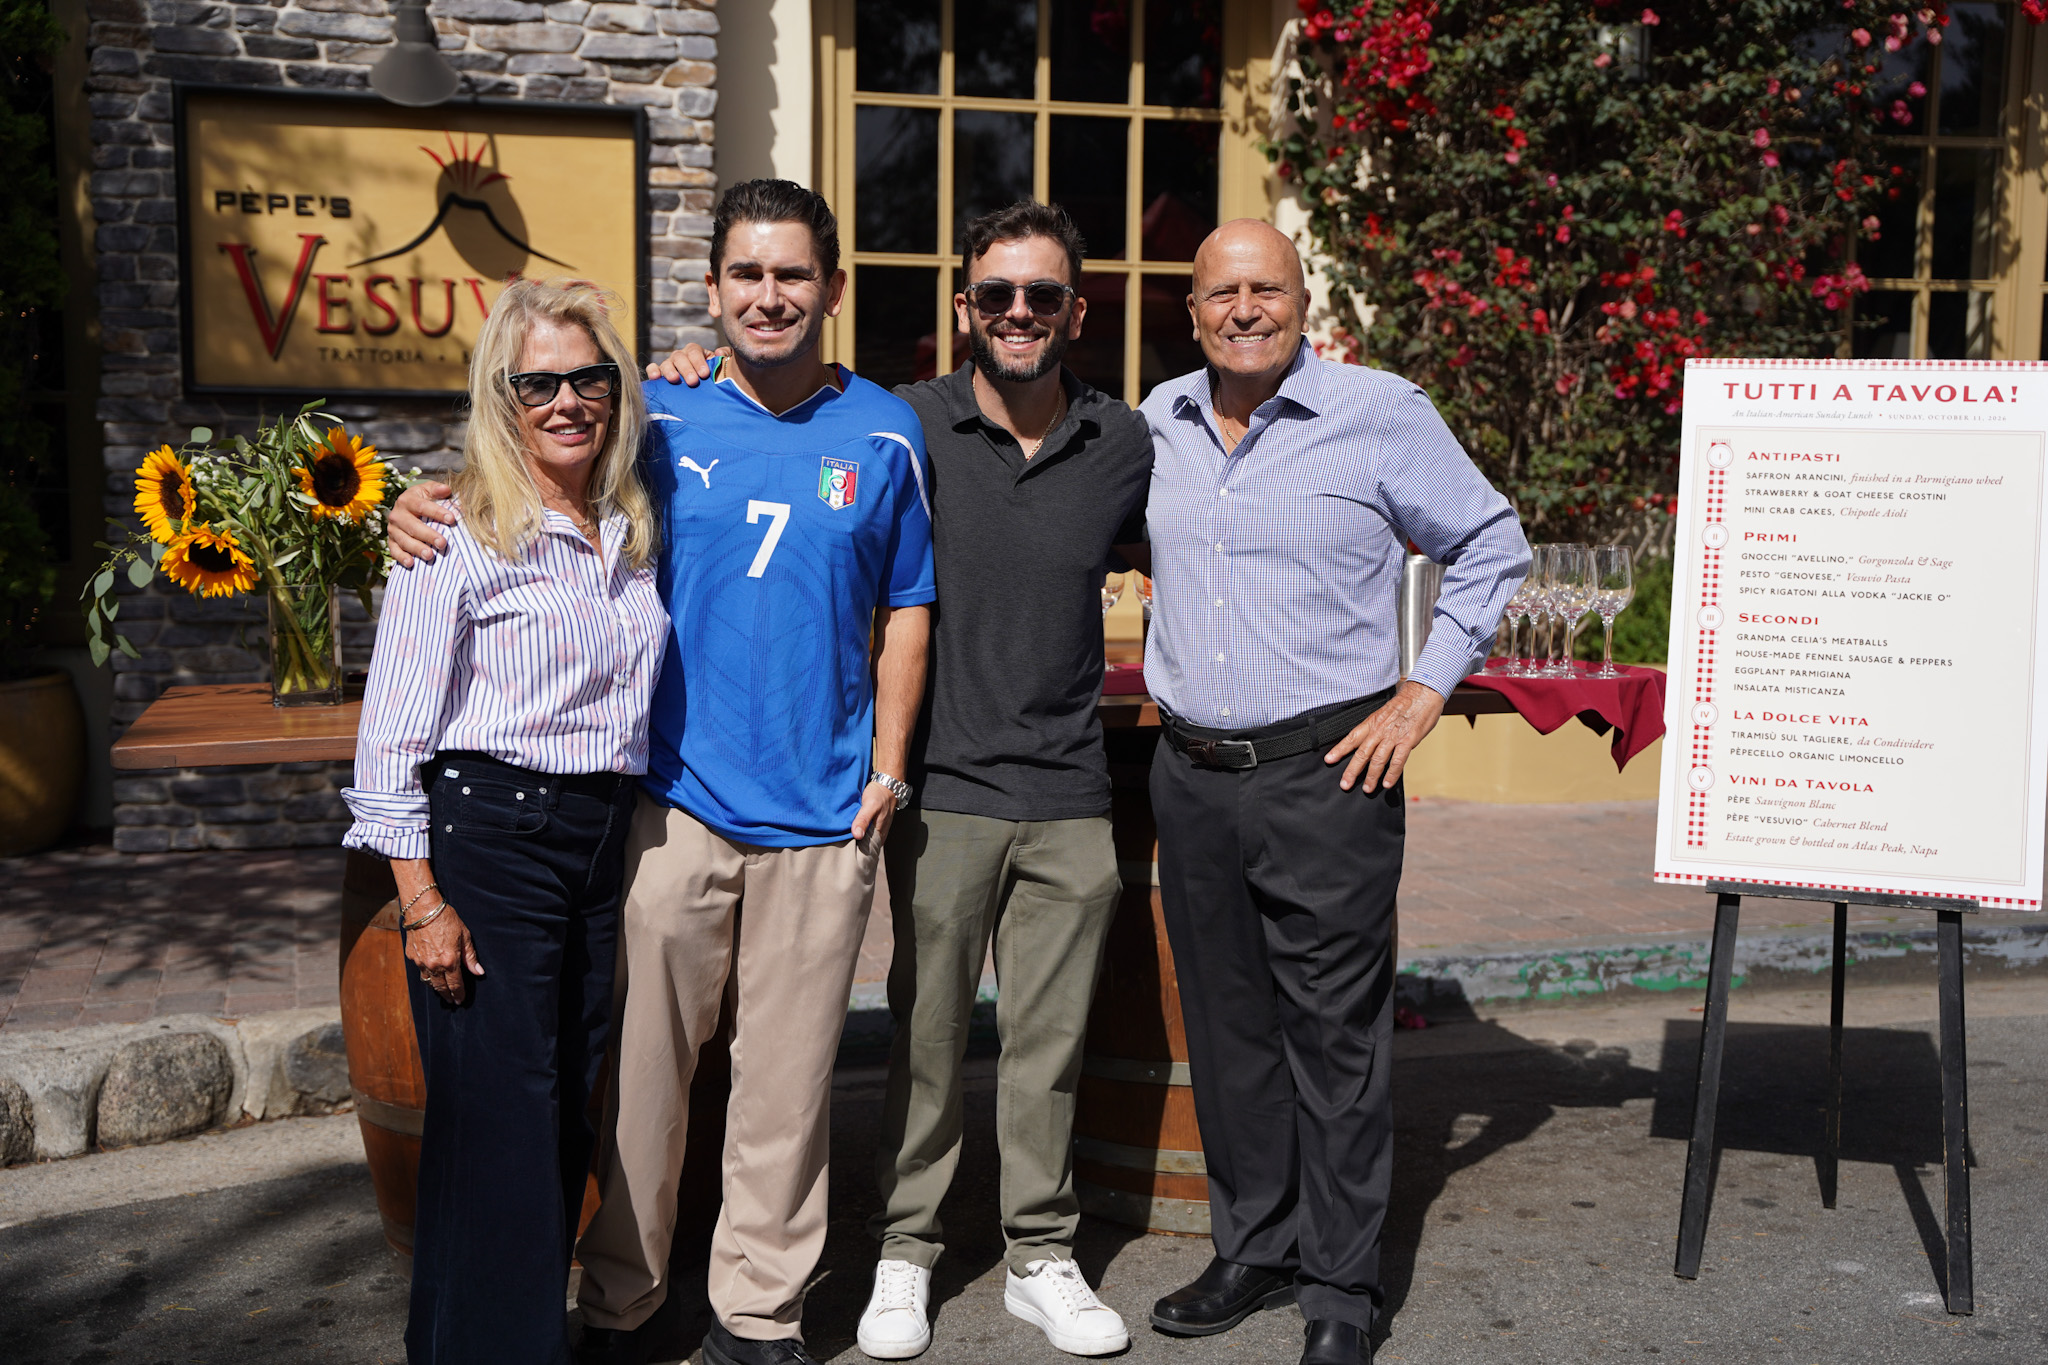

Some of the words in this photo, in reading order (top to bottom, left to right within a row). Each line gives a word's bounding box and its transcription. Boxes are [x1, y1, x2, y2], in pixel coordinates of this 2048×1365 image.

[215, 184, 352, 219] PÈPE'S
[318, 347, 424, 365] TRATTORIA
[1723, 382, 1817, 400] TUTTI
[1832, 384, 1853, 401] A
[1867, 384, 2018, 403] TAVOLA!
[1732, 409, 1744, 418] An
[1746, 409, 1814, 418] Italian-American
[1815, 410, 1846, 421] Sunday
[1847, 411, 1873, 420] Lunch
[1747, 451, 1840, 462] ANTIPASTI
[826, 460, 854, 471] ITALIA
[1746, 472, 1791, 480] SAFFRON
[1795, 473, 1847, 482] ARANCINI,
[1848, 472, 1889, 485] finished
[1892, 475, 1903, 483] in
[1914, 474, 1973, 487] Parmigiano
[1976, 475, 2004, 485] wheel
[1745, 488, 1809, 497] STRAWBERRY
[1813, 490, 1819, 498] &
[1824, 491, 1852, 499] GOAT
[1856, 491, 1894, 500] CHEESE
[1899, 492, 1947, 501] CROSTINI
[1744, 506, 1765, 514] MINI
[1769, 507, 1795, 515] CRAB
[1799, 507, 1835, 517] CAKES,
[1840, 506, 1881, 520] Chipotle
[1882, 508, 1908, 518] Aioli
[746, 499, 791, 579] 7
[1744, 532, 1797, 543] PRIMI
[1741, 552, 1787, 561] GNOCCHI
[1858, 554, 1914, 568] Gorgonzola
[1917, 556, 1929, 566] &
[1929, 557, 1953, 570] Sage
[1740, 570, 1770, 578] PESTO
[1846, 572, 1882, 583] Vesuvio
[1884, 574, 1911, 584] Pasta
[1739, 586, 1766, 595] SPICY
[1770, 588, 1817, 597] RIGATONI
[1821, 589, 1846, 598] ALLA
[1851, 591, 1886, 600] VODKA
[1738, 612, 1819, 625] SECONDI
[1736, 633, 1786, 642] GRANDMA
[1831, 637, 1888, 647] MEATBALLS
[1735, 650, 1801, 660] HOUSE-MADE
[1805, 652, 1844, 662] FENNEL
[1848, 654, 1893, 664] SAUSAGE
[1897, 657, 1904, 665] &
[1910, 657, 1953, 667] PEPPERS
[1734, 666, 1786, 676] EGGPLANT
[1790, 669, 1851, 679] PARMIGIANA
[1733, 683, 1780, 693] INSALATA
[1784, 685, 1845, 696] MISTICANZA
[1733, 710, 1754, 720] LA
[1762, 711, 1822, 724] DOLCE
[1829, 715, 1869, 727] VITA
[1731, 731, 1777, 741] TIRAMISÙ
[1781, 733, 1798, 742] SUL
[1803, 734, 1853, 746] TAGLIERE,
[1856, 736, 1870, 746] da
[1873, 737, 1935, 750] Condividere
[1789, 751, 1835, 761] ORGANIC
[1839, 754, 1904, 765] LIMONCELLO
[1729, 774, 1766, 786] VINI
[1775, 778, 1798, 788] DA
[1805, 779, 1874, 793] TAVOLA
[1727, 794, 1750, 804] PÈPE
[1754, 796, 1806, 809] Sauvignon
[1808, 798, 1837, 810] Blanc
[1726, 812, 1749, 822] PÈPE
[1813, 817, 1857, 830] Cabernet
[1859, 820, 1889, 832] Blend
[1725, 832, 1754, 843] Estate
[1755, 837, 1786, 846] grown
[1789, 835, 1801, 846] &
[1801, 837, 1835, 849] bottled
[1851, 841, 1878, 852] Atlas
[1880, 842, 1907, 855] Peak,
[1910, 844, 1938, 858] Napa
